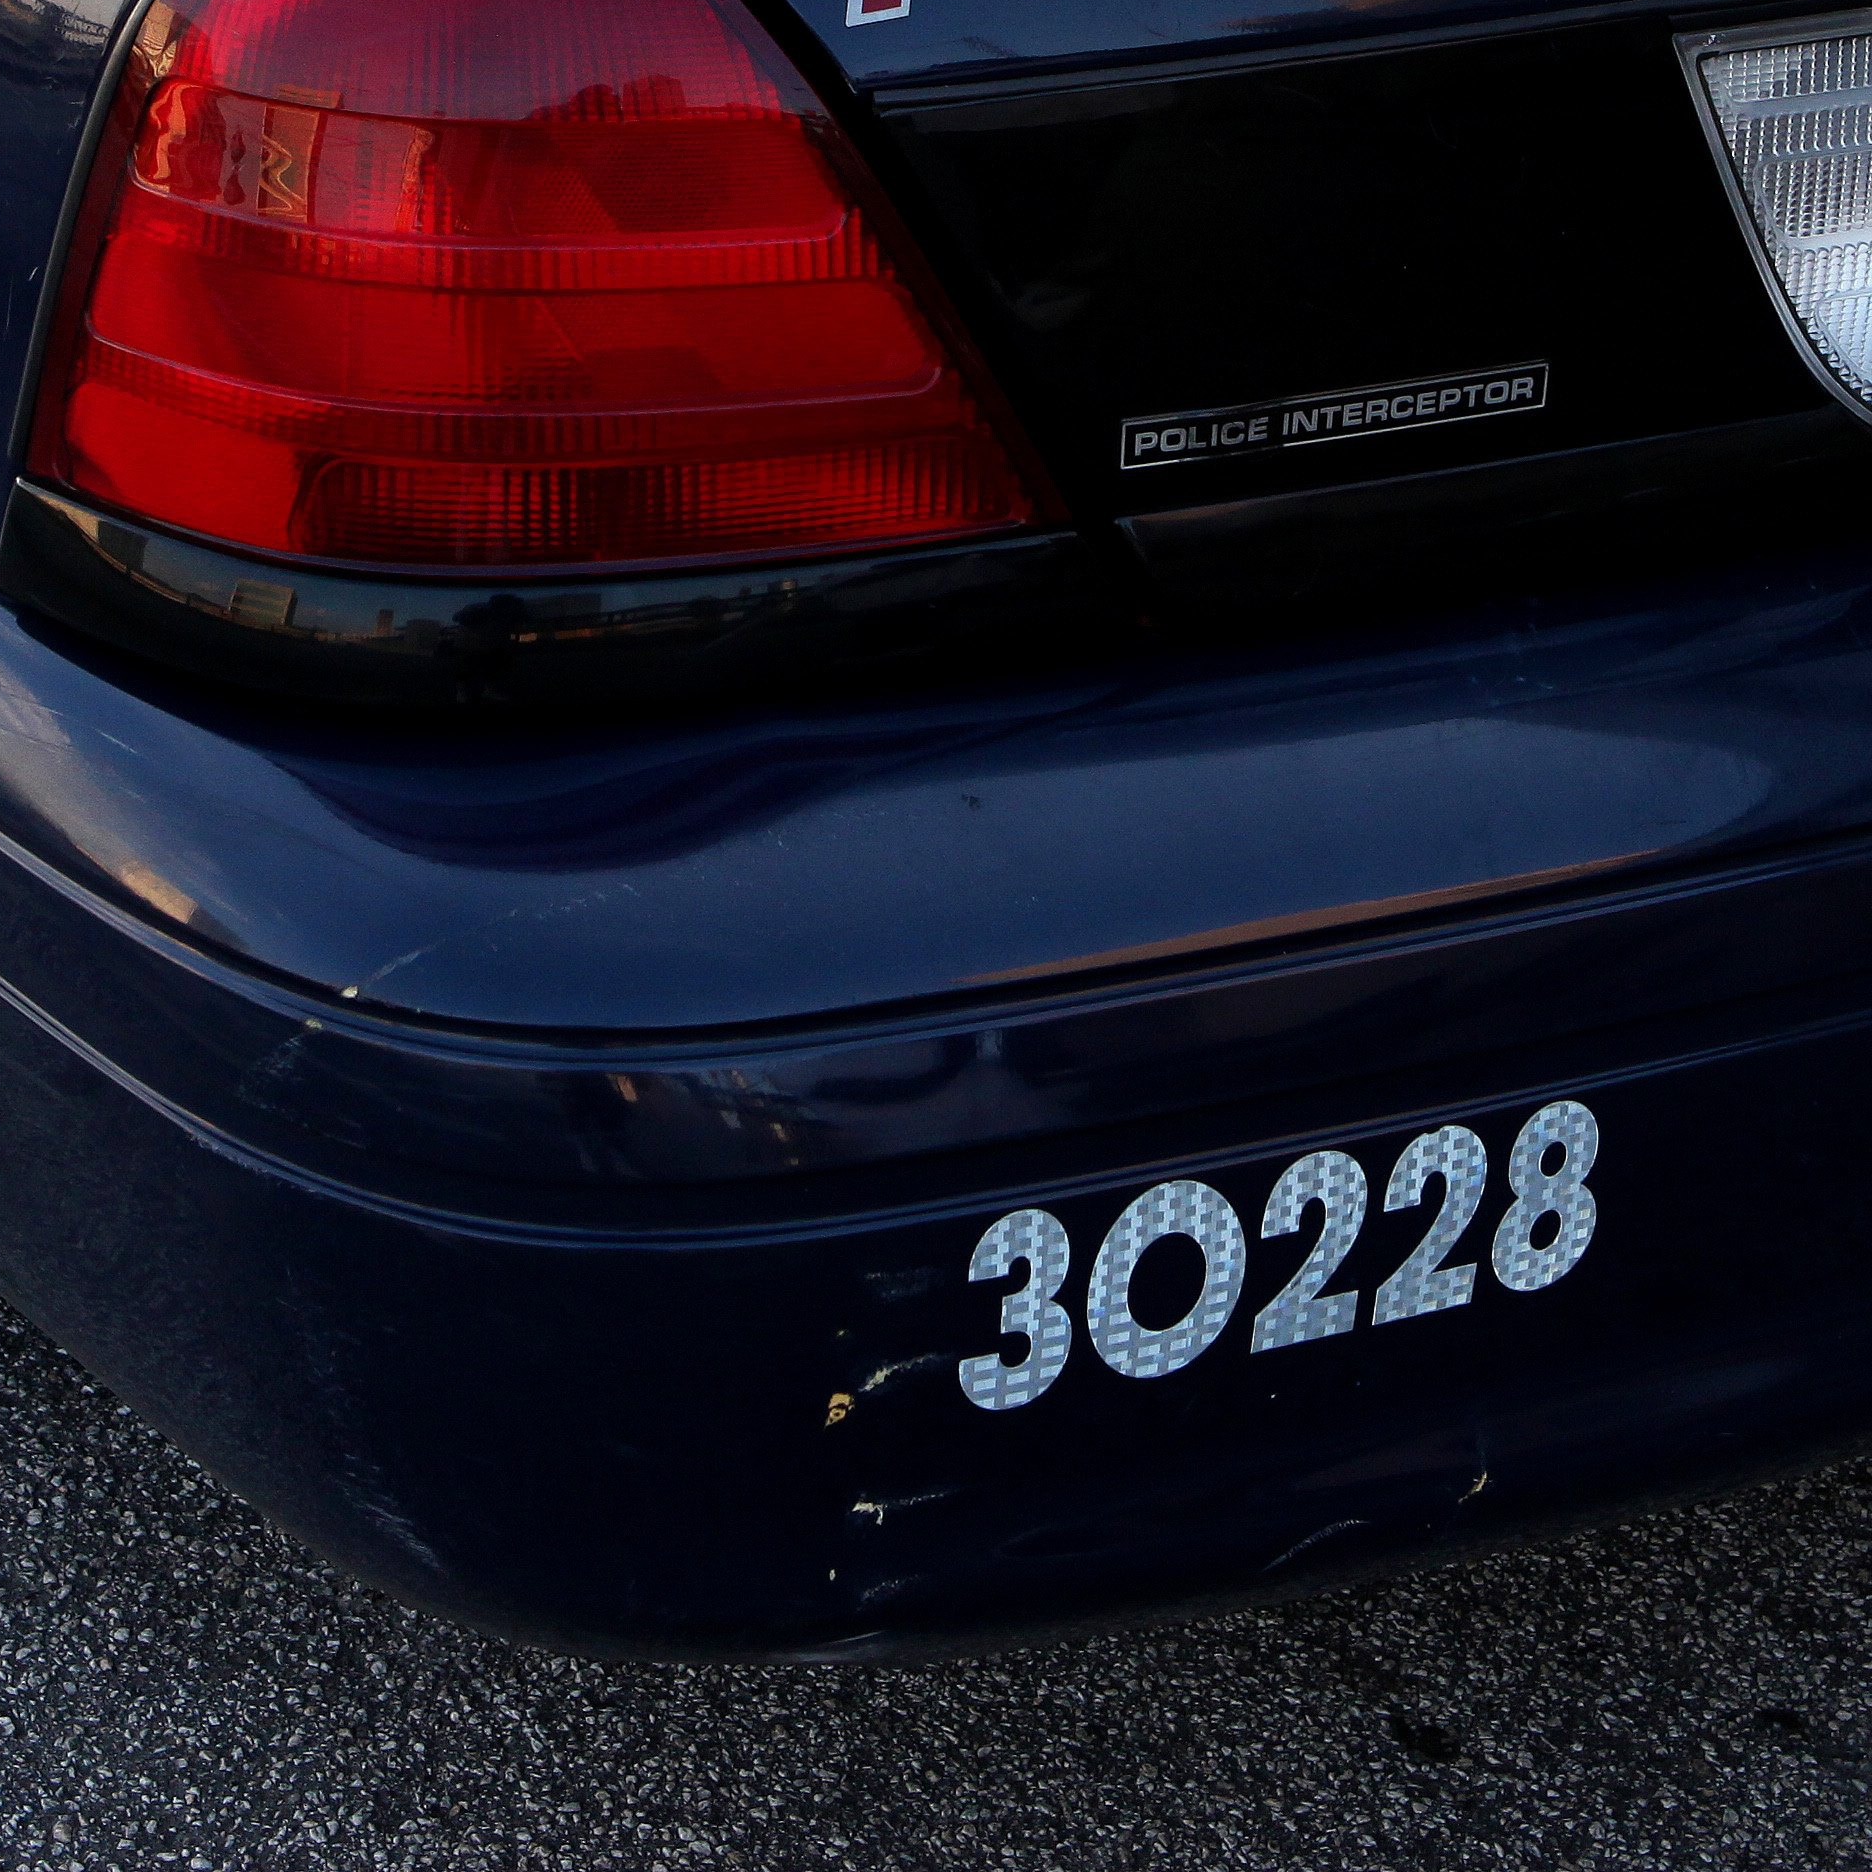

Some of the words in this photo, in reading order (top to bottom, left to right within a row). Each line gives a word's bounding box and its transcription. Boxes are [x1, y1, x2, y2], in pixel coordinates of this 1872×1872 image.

[1134, 416, 1270, 457] POLICE
[1282, 376, 1535, 436] INTERCEPTOR
[958, 1100, 1599, 1411] 30228
